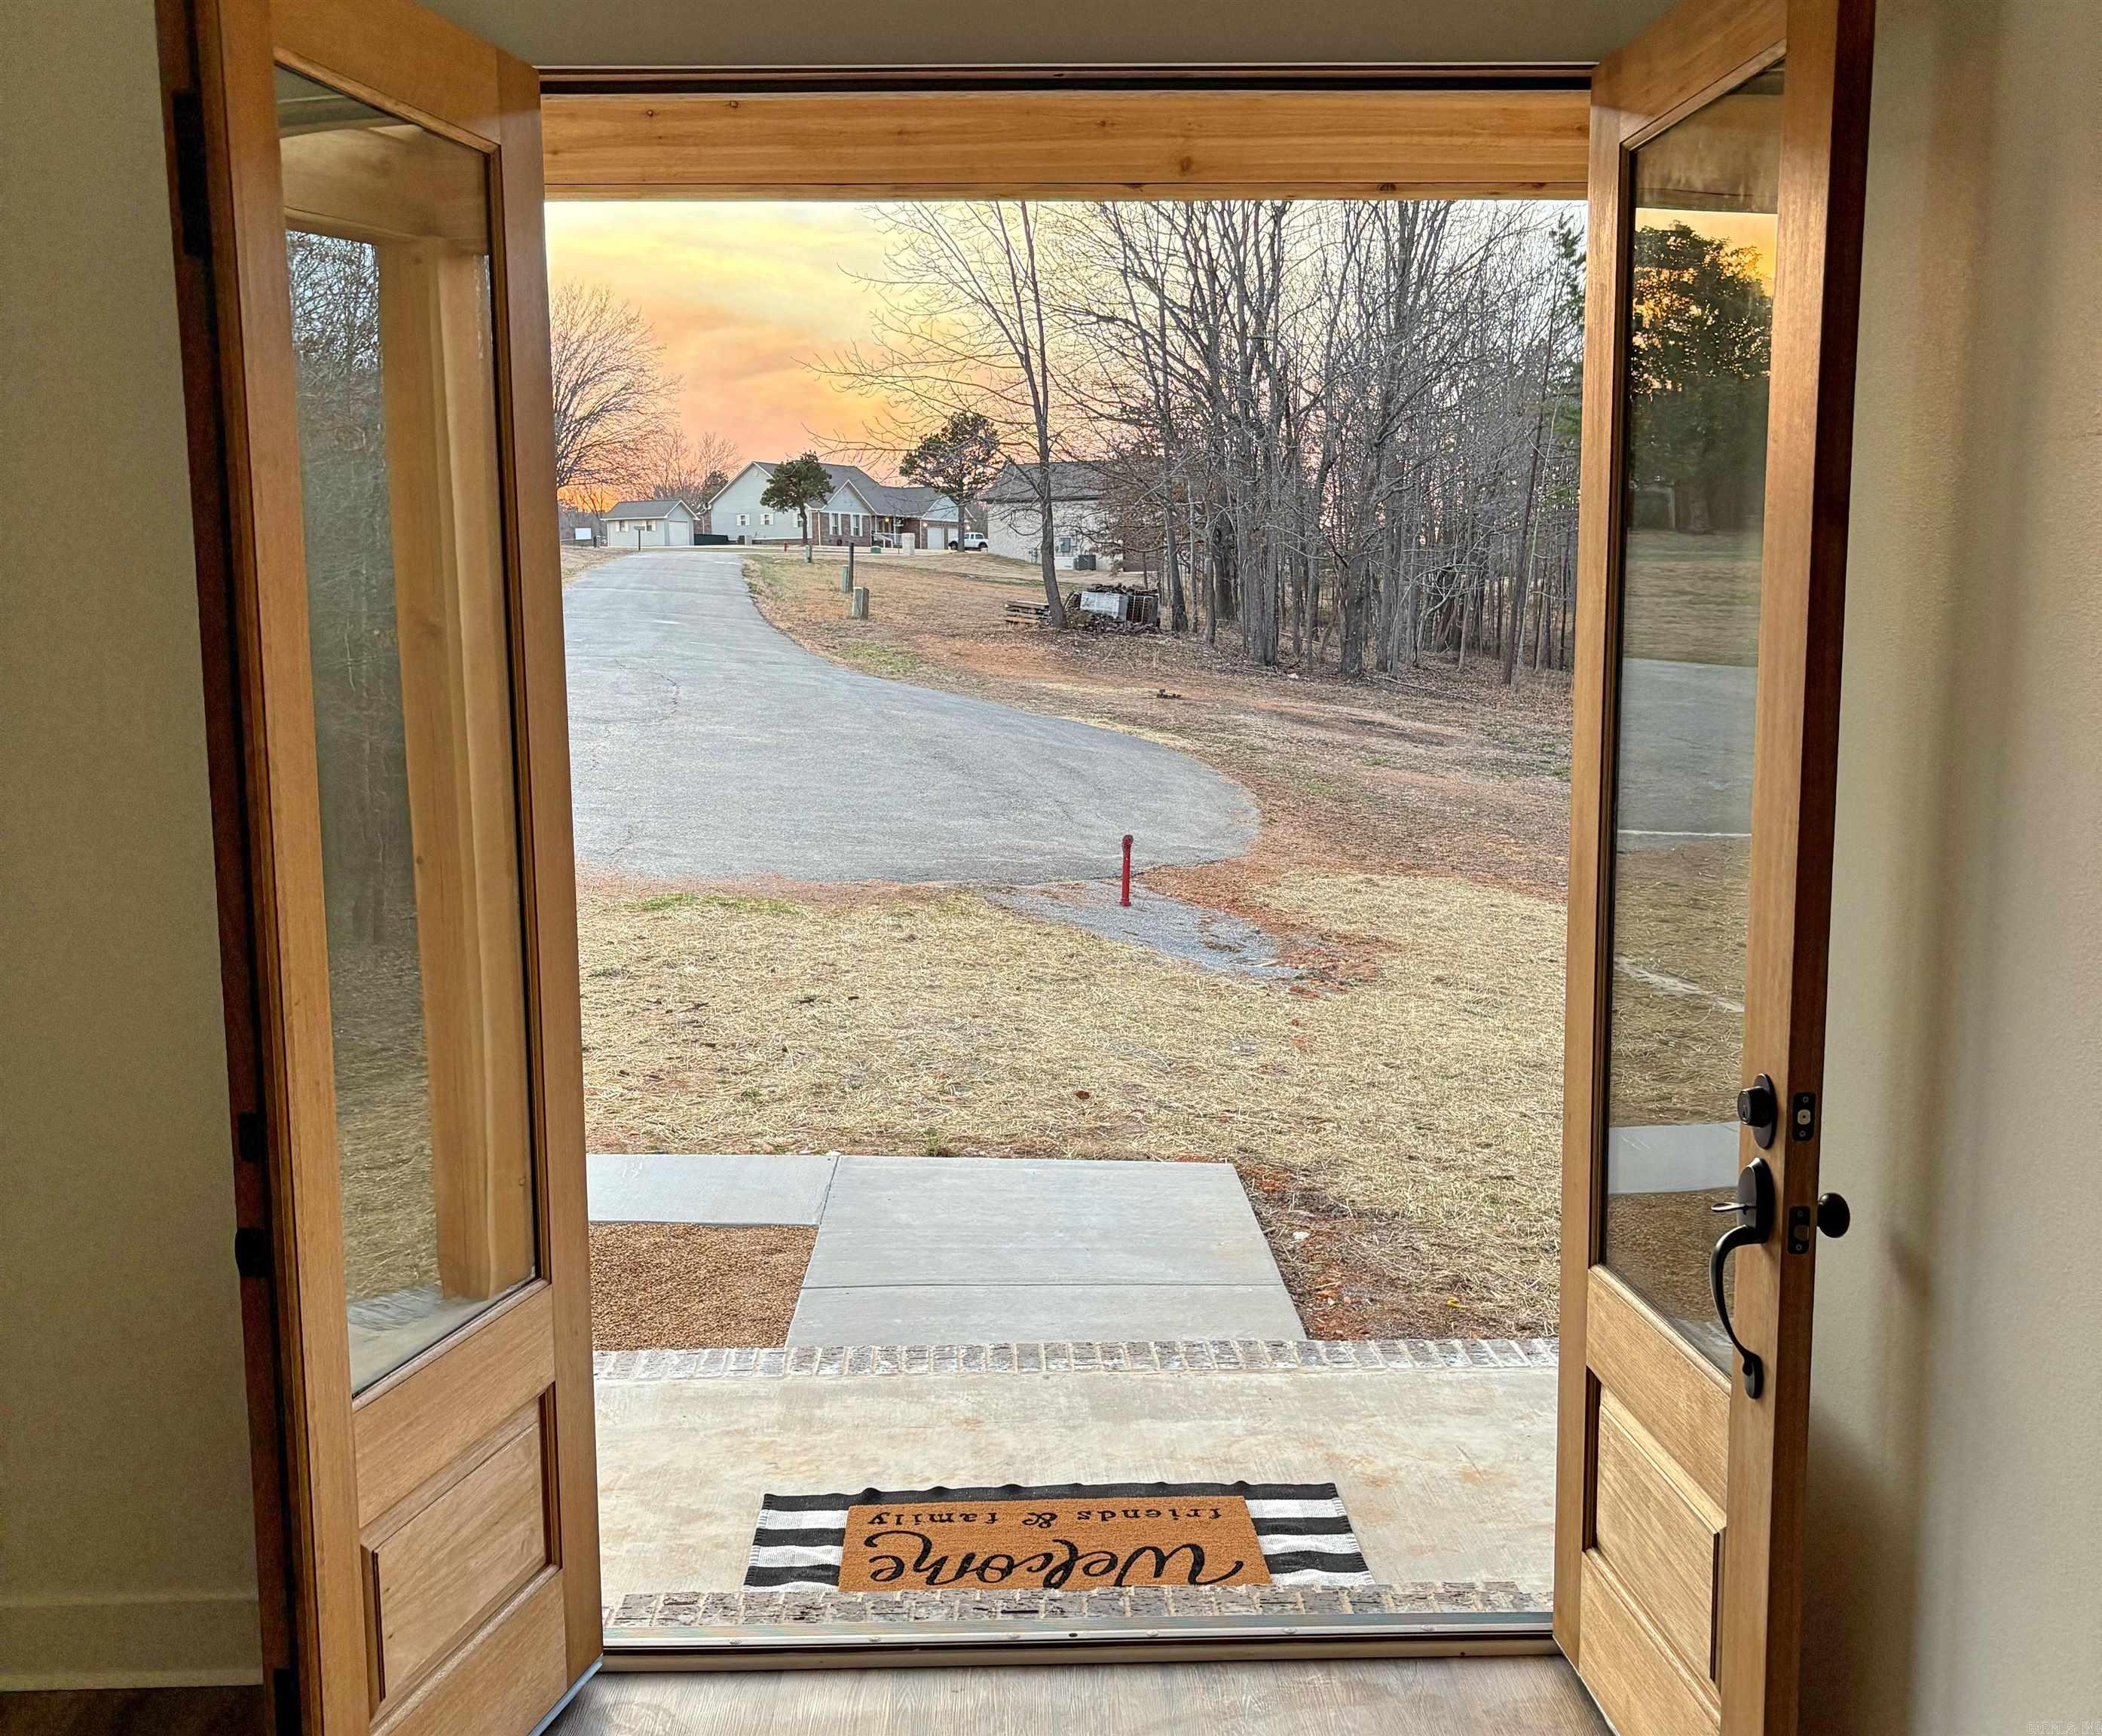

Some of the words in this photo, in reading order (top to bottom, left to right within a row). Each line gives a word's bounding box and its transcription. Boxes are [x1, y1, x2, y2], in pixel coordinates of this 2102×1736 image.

[867, 1511, 999, 1526] family
[1021, 1511, 1058, 1529] &
[1077, 1508, 1222, 1523] friends
[863, 1530, 1245, 1590] Welcome
